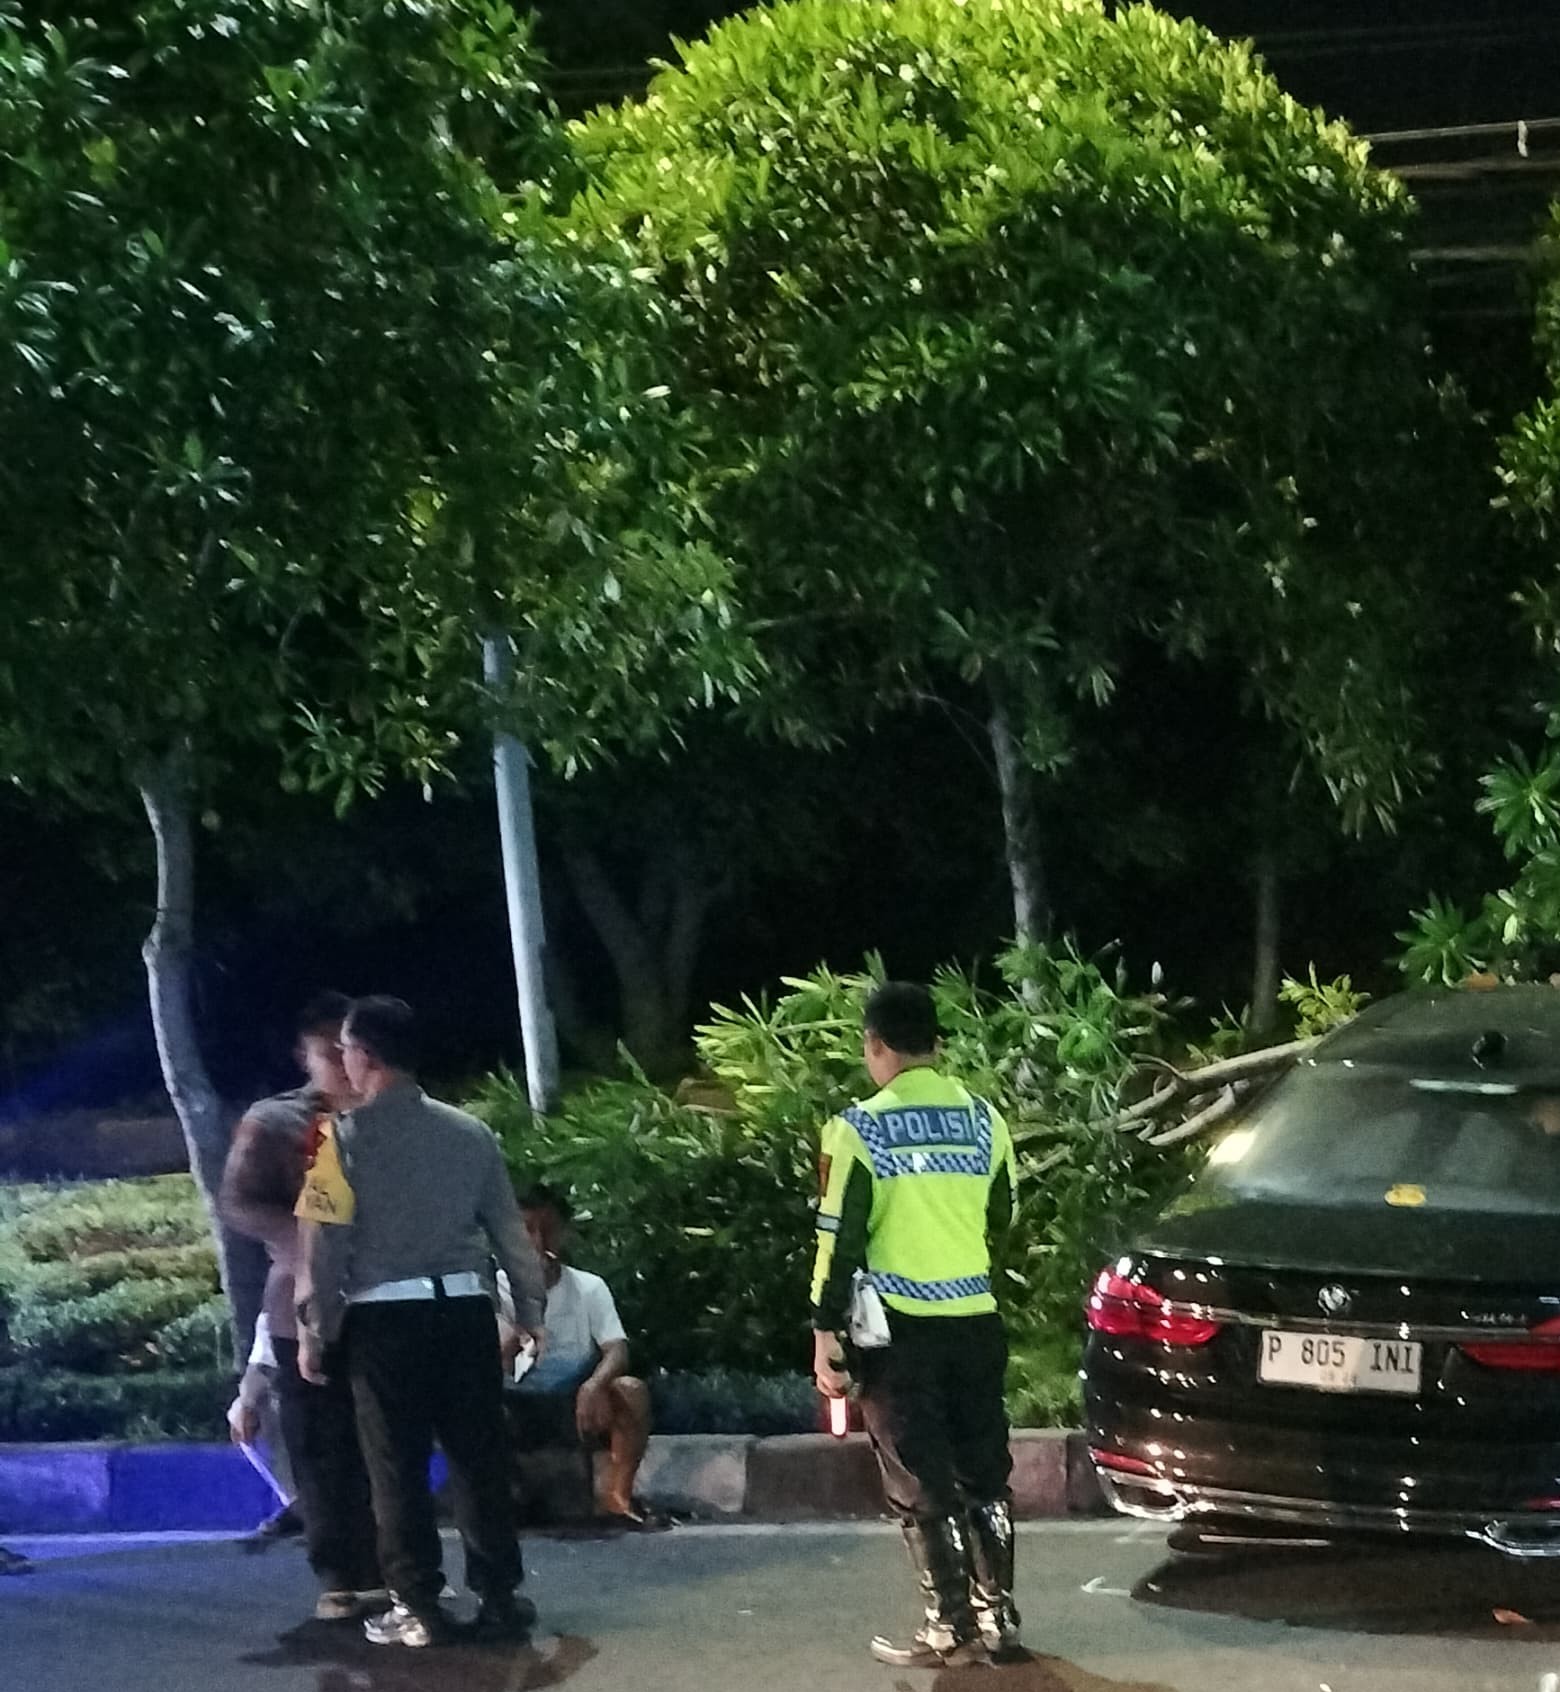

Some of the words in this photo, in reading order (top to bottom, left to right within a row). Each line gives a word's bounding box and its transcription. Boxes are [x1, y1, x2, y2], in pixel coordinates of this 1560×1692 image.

[886, 1110, 975, 1142] POLISI
[1268, 1335, 1282, 1362] P
[1301, 1338, 1346, 1367] 805
[1370, 1343, 1415, 1374] INI
